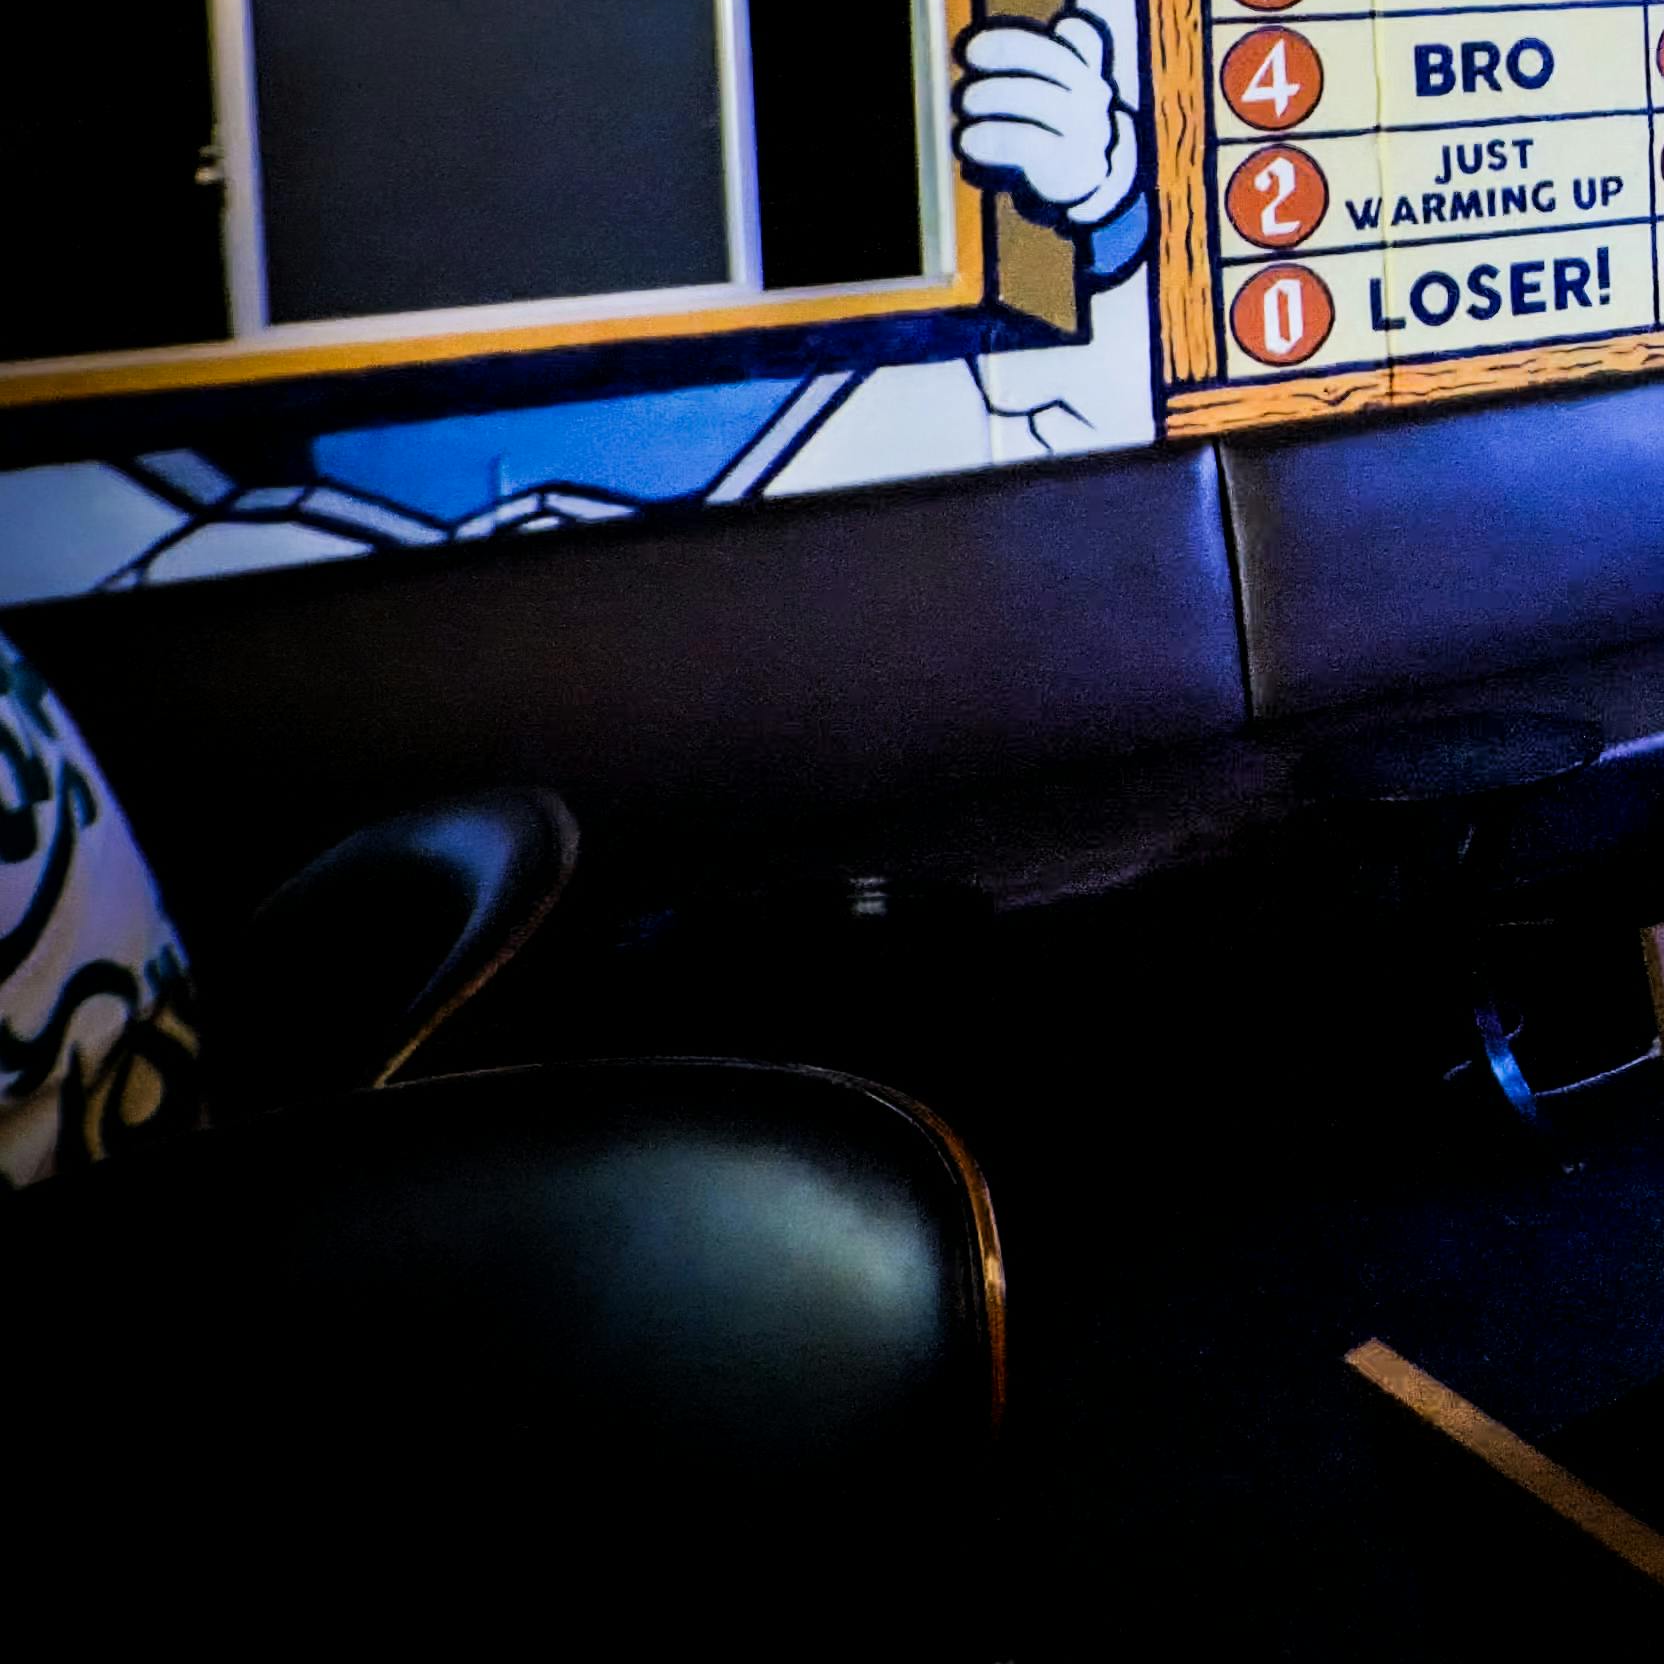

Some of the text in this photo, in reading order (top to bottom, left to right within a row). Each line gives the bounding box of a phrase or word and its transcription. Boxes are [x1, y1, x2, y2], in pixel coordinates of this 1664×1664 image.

[1240, 39, 1300, 118] 4
[1414, 37, 1554, 97] BRO
[1254, 156, 1300, 237] 2
[1435, 139, 1534, 185] JUST
[1345, 176, 1624, 230] WARMING UP
[1263, 278, 1304, 355] 0
[1369, 246, 1611, 332] LOSER!
